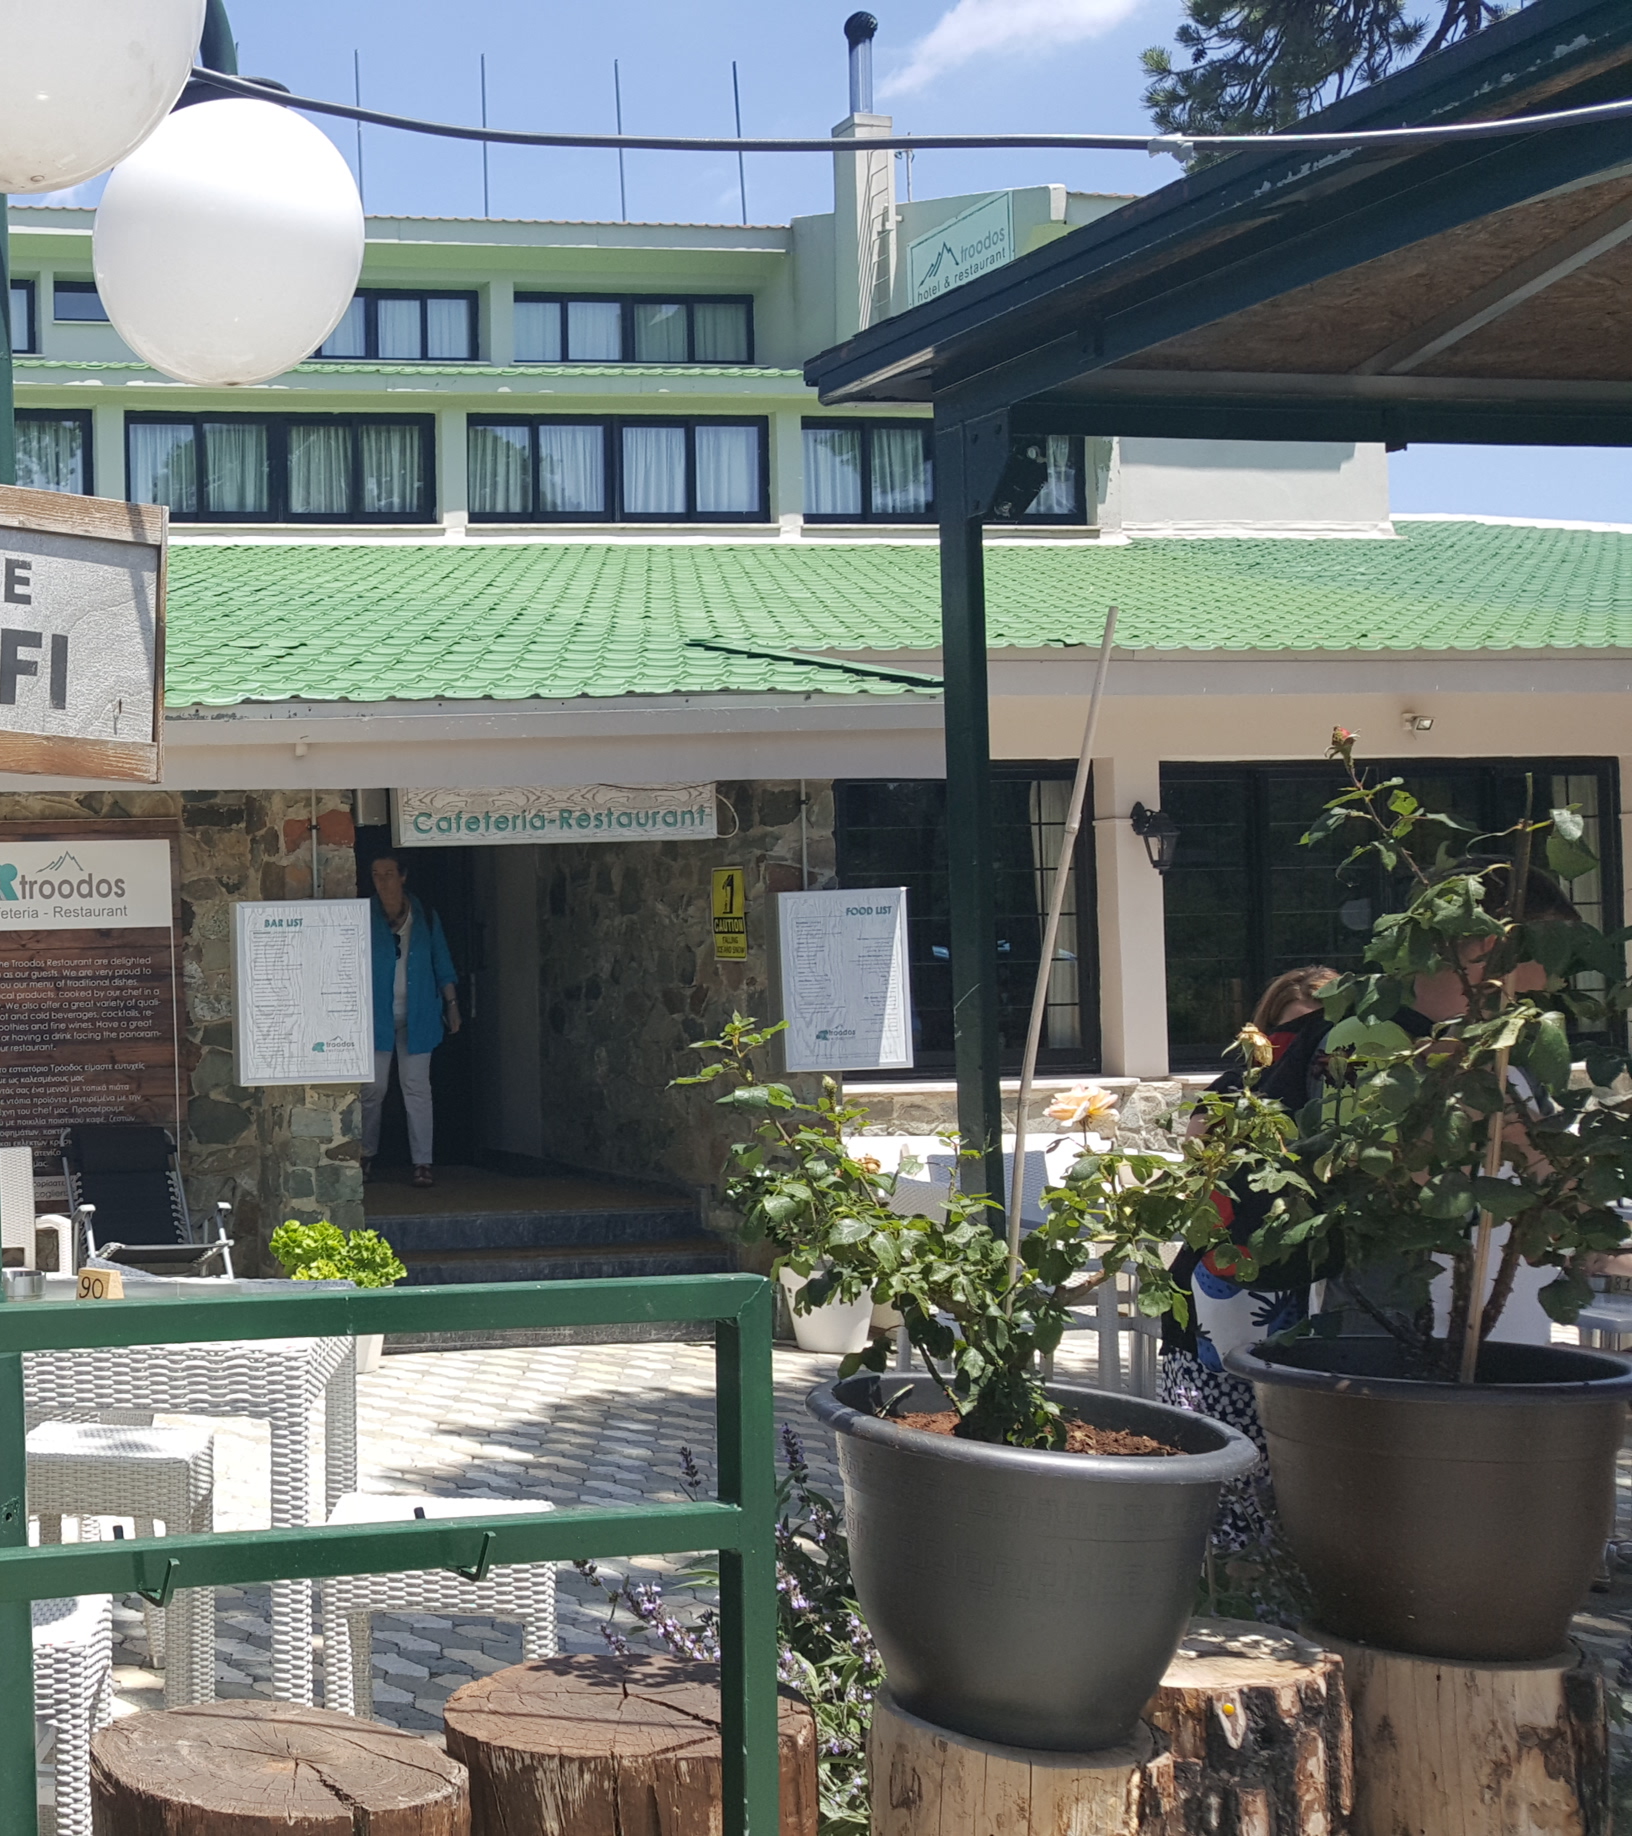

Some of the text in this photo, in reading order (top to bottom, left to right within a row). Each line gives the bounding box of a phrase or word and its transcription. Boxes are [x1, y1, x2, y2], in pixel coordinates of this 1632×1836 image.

[960, 228, 1005, 263] troodos
[918, 247, 1006, 302] hotel & restaurant
[413, 805, 707, 834] Cafeteria-Restaurant
[20, 873, 126, 900] troodos
[722, 874, 734, 914] 1
[53, 905, 128, 918] Restaurant
[846, 906, 892, 916] FOOD LIST
[264, 918, 304, 928] BAR LIST
[714, 919, 744, 932] CAUTION
[12, 960, 45, 968] Troodos
[47, 958, 92, 967] Restaurant
[110, 956, 152, 966] delighted
[115, 968, 140, 976] proud
[56, 980, 64, 988] of
[67, 978, 110, 986] traditional
[59, 990, 92, 998] cooked
[94, 990, 104, 998] by
[122, 988, 142, 996] chef
[144, 988, 152, 996] in
[6, 1002, 20, 1010] We
[41, 1000, 60, 1008] offer
[71, 1000, 94, 1010] great
[96, 998, 124, 1008] variety
[127, 998, 136, 1006] of
[10, 1012, 28, 1020] and
[30, 1012, 50, 1020] cold
[30, 1022, 48, 1030] and
[50, 1022, 66, 1030] fine
[96, 1020, 118, 1028] Have
[129, 1020, 152, 1028] great
[12, 1032, 42, 1042] having
[52, 1032, 72, 1040] drink
[74, 1032, 101, 1040] facing
[104, 1030, 118, 1038] the
[10, 1044, 57, 1052] restaurant.
[79, 1276, 104, 1299] 90
